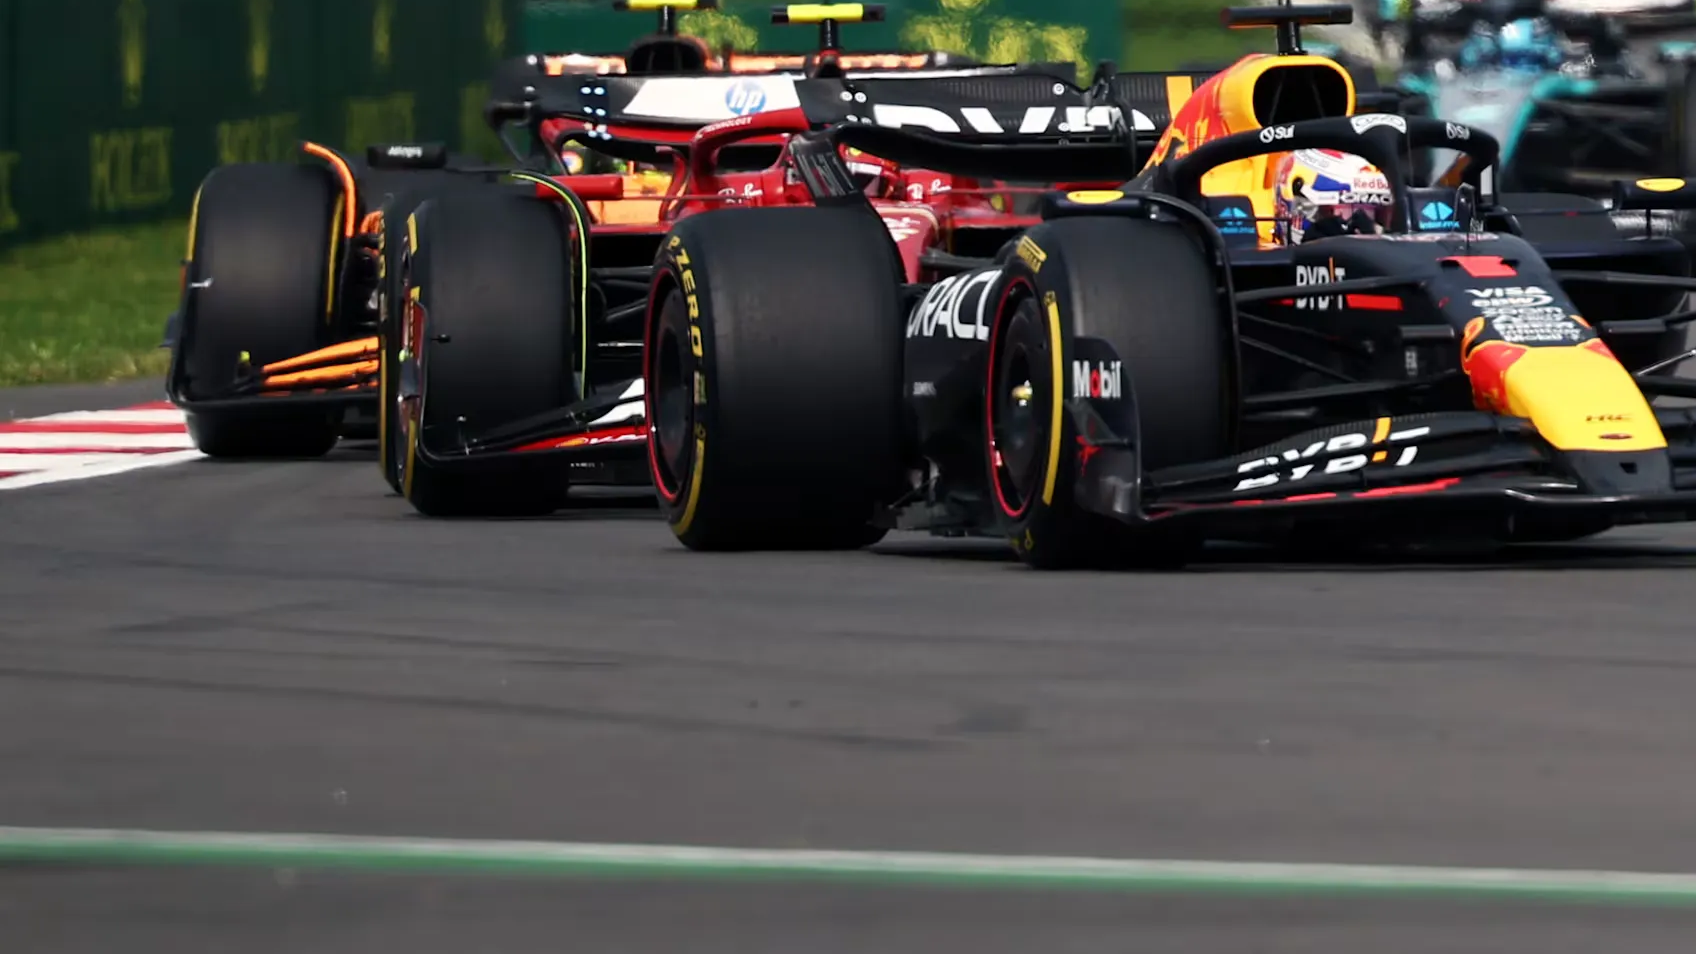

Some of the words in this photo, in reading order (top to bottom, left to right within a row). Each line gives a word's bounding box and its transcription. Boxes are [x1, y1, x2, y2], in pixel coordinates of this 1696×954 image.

[727, 80, 765, 117] hp
[1341, 191, 1394, 205] ORAC
[1353, 177, 1377, 189] Red
[1377, 178, 1391, 190] Bu
[676, 249, 704, 358] ZERO
[906, 269, 1003, 341] ORACL
[1465, 286, 1548, 298] VISA
[1072, 360, 1122, 398] Mobil
